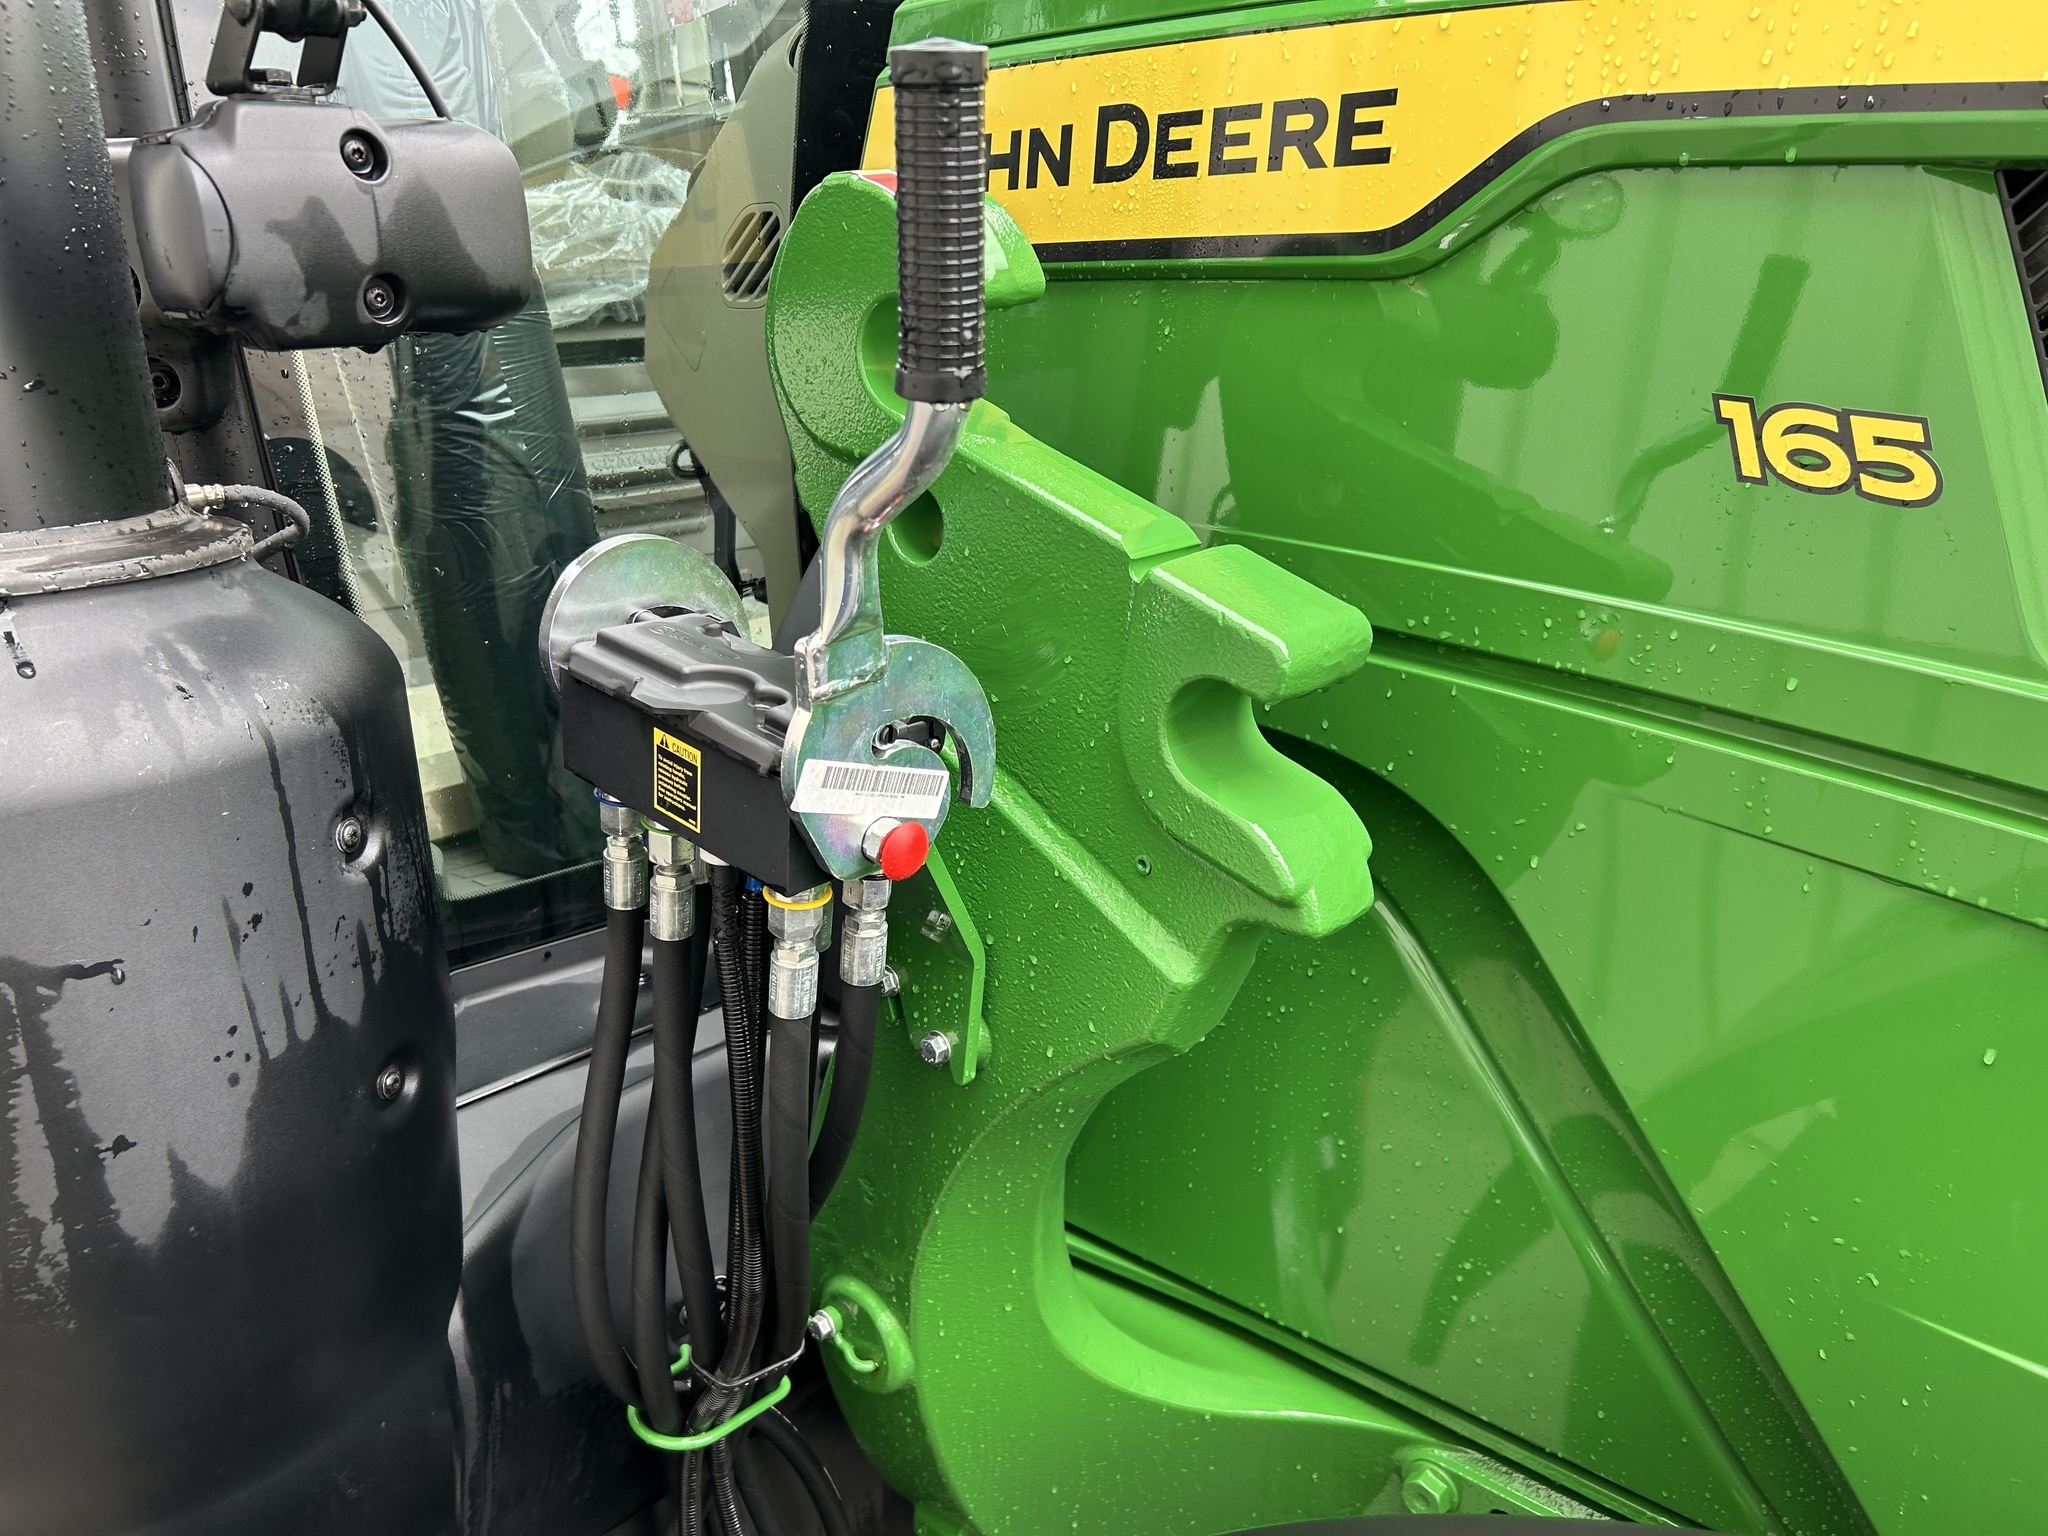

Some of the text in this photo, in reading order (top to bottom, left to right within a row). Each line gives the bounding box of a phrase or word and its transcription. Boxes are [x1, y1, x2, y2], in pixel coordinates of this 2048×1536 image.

[985, 88, 1398, 192] HN DEERE
[1714, 395, 1941, 506] 165
[672, 743, 697, 764] CAUTION
